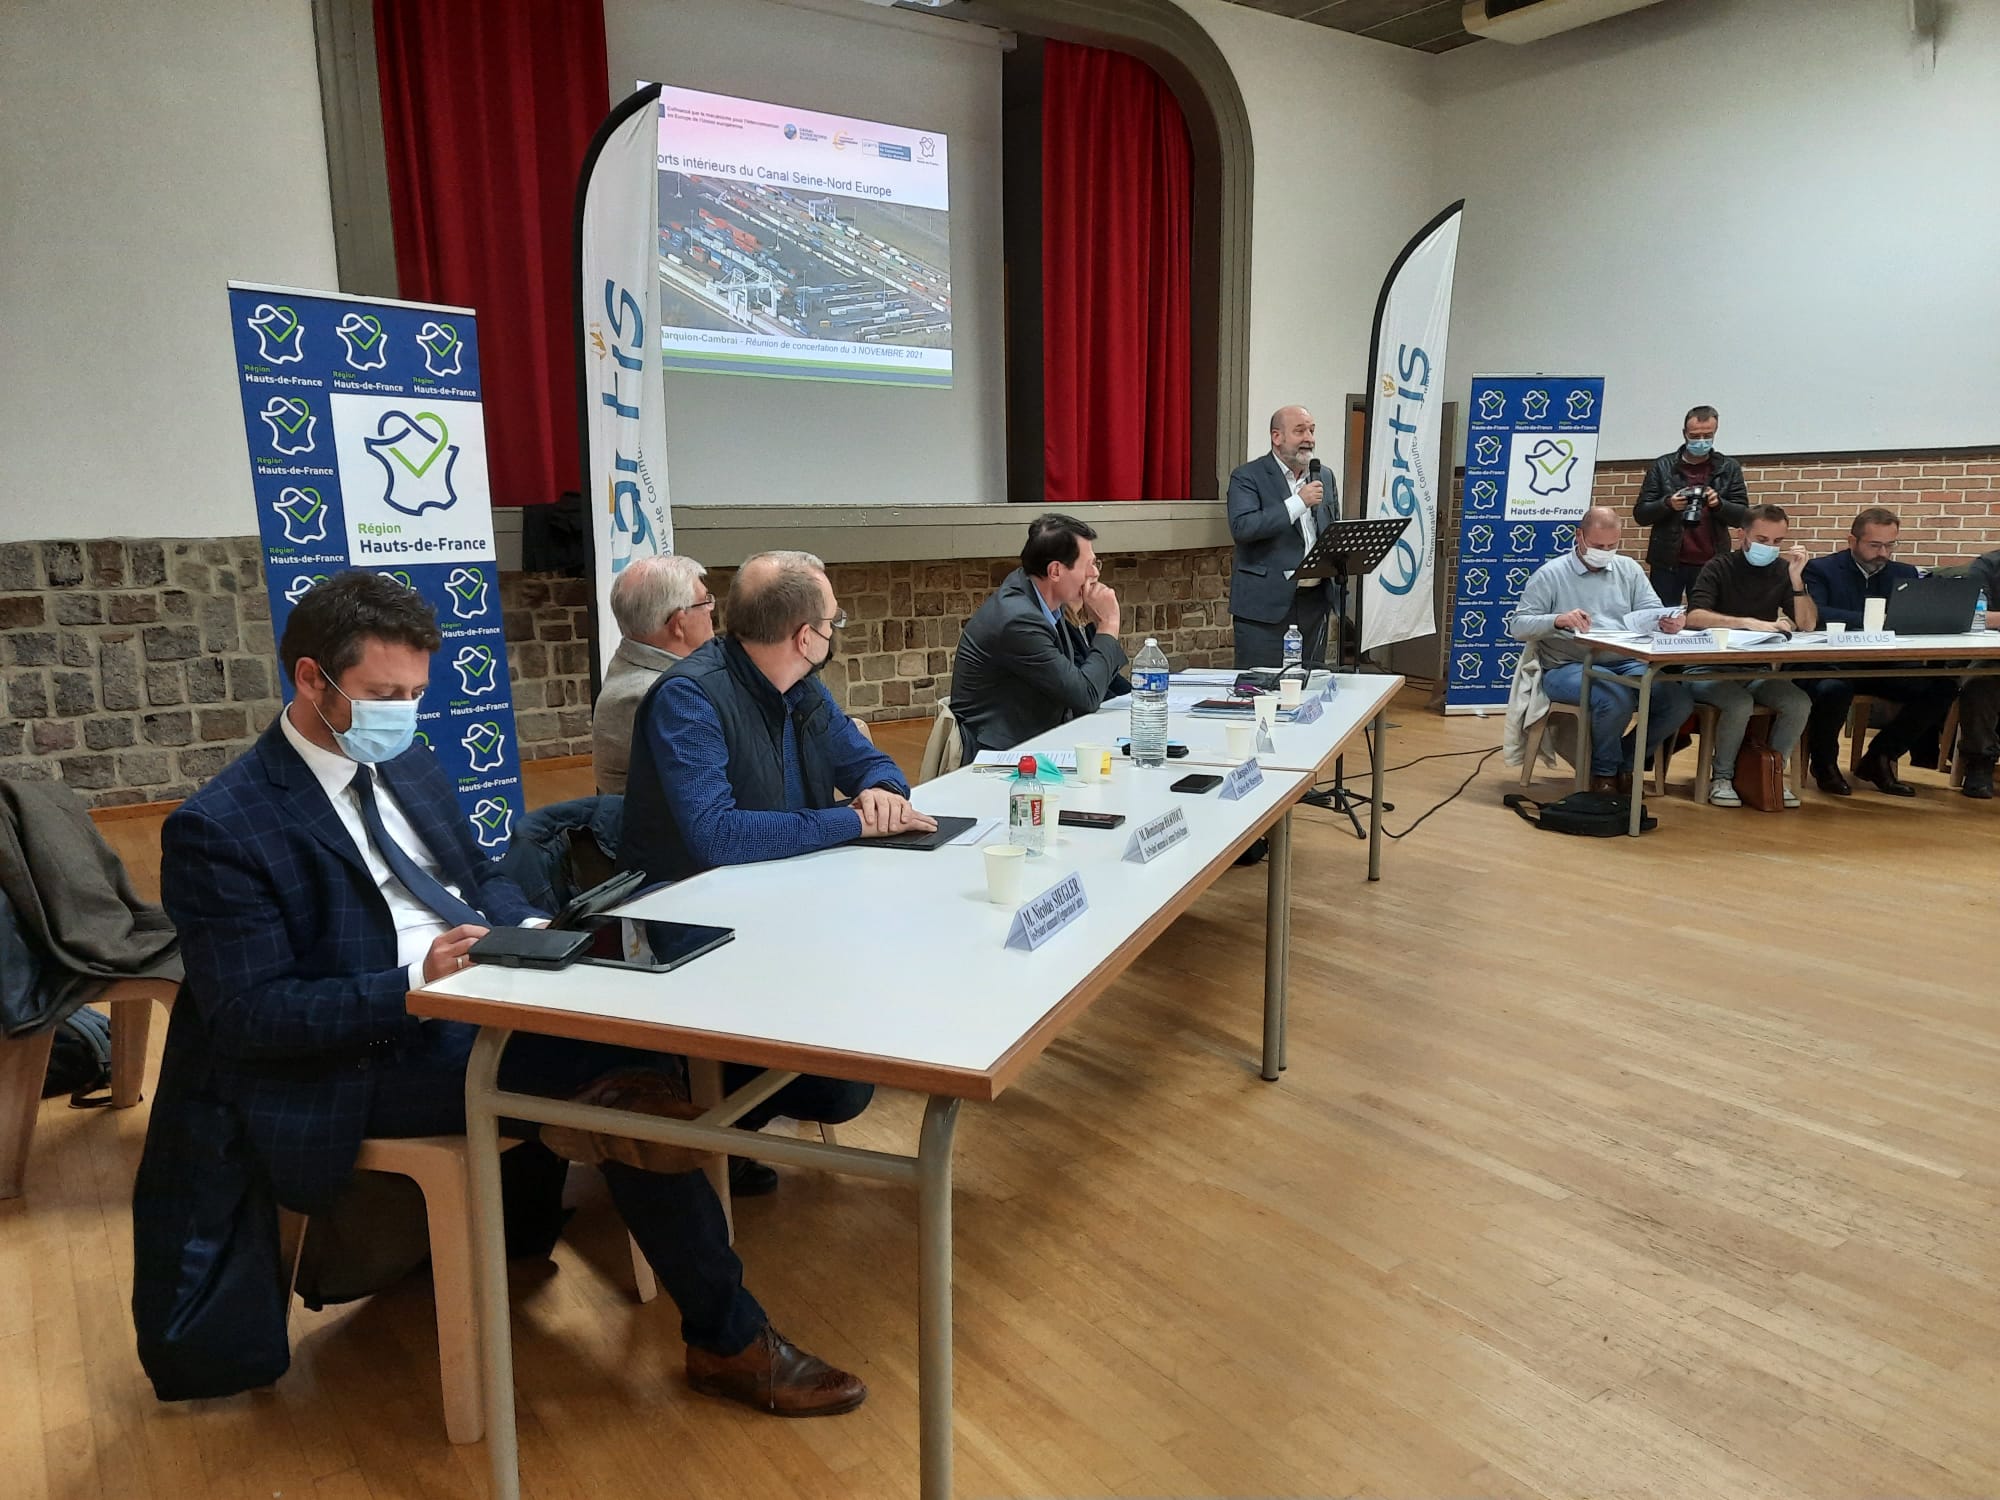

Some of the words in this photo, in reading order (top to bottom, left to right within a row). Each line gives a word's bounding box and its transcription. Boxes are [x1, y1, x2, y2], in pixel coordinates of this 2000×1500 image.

[657, 153, 680, 166] orts
[682, 154, 736, 175] intérieurs
[739, 163, 754, 177] du
[757, 165, 789, 182] Canal
[792, 171, 852, 191] Seine-Nord
[855, 181, 892, 197] Europe
[661, 331, 738, 345] arquion-Cambrai
[745, 336, 778, 348] Réunion
[780, 340, 791, 349] de
[840, 345, 849, 353] du
[851, 346, 857, 354] 3
[858, 346, 904, 358] NOVEMBRE
[906, 350, 923, 359] 2021
[245, 373, 323, 387] Hauts-de-France
[333, 379, 404, 393] Hauts-de-France
[413, 385, 477, 397] Hauts-de-France
[258, 465, 334, 475] Hauts-de-France
[1424, 490, 1431, 502] de
[1510, 507, 1584, 516] Hauts-de-France
[358, 522, 402, 536] Région
[359, 537, 486, 553] Hauts-de-France
[270, 553, 345, 565] Hauts-de-France
[442, 627, 500, 638] Hauts-de-France
[1837, 634, 1890, 643] URBICUS
[1673, 636, 1714, 645] CONSULTING
[450, 702, 509, 716] Hauts-de-France
[458, 776, 518, 793] Hauts-de-France
[1023, 910, 1035, 927] M.
[1031, 899, 1054, 920] Nicolas
[1051, 878, 1080, 908] SIEGLER
